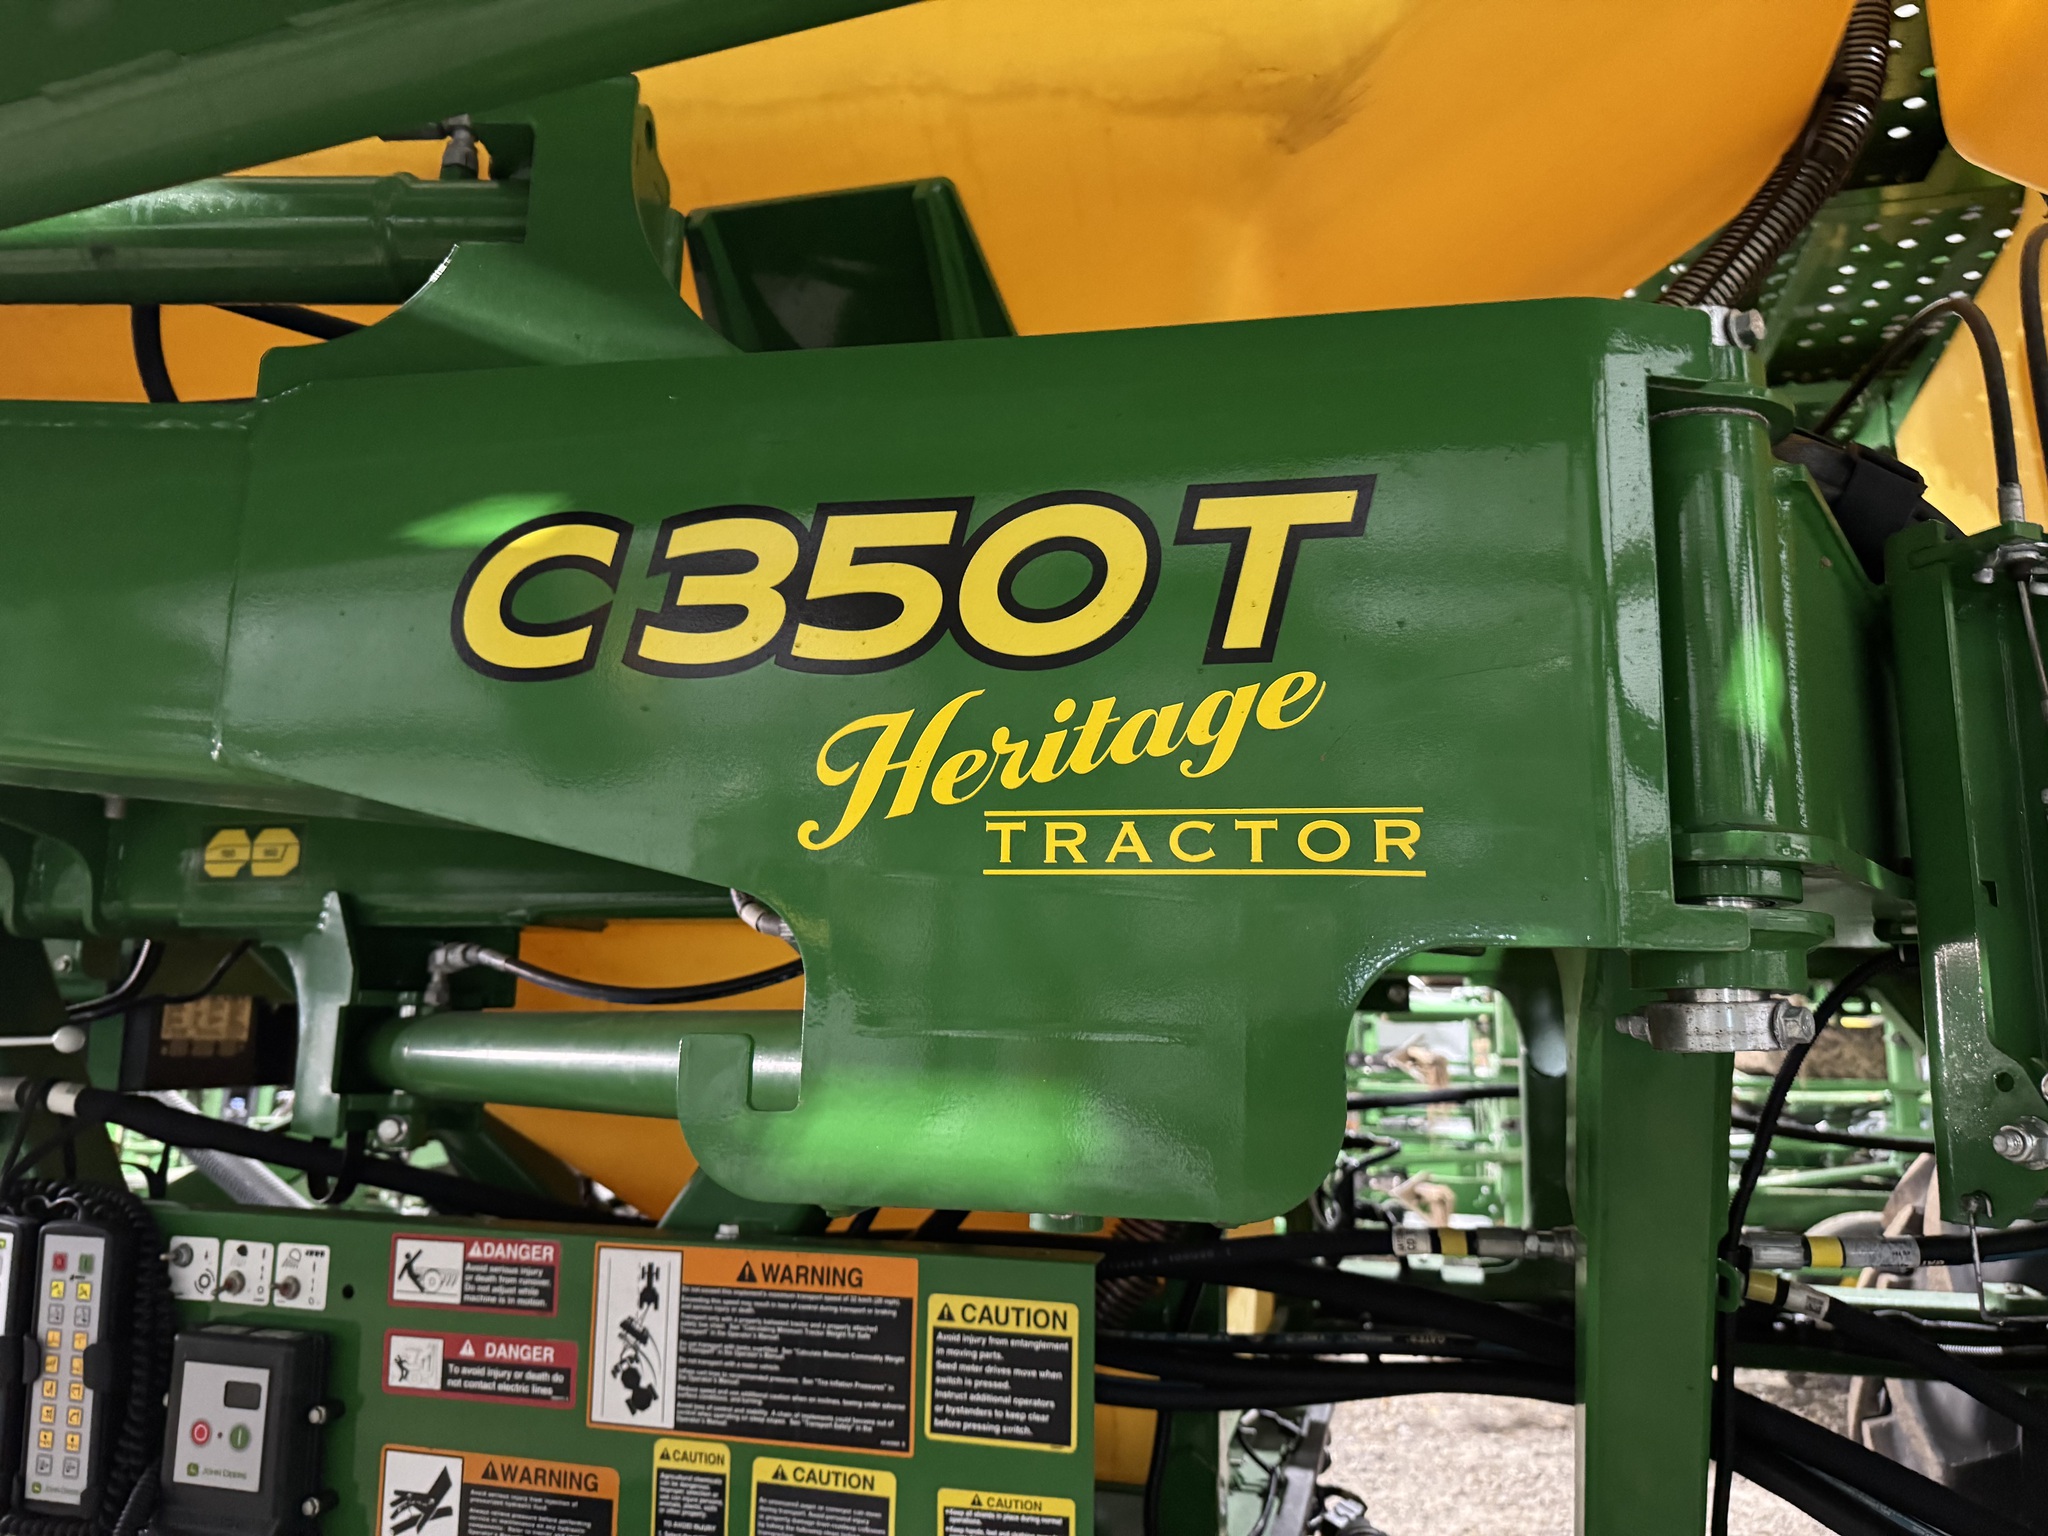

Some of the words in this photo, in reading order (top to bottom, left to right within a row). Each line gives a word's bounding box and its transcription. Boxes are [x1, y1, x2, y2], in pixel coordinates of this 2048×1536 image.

[451, 473, 1377, 682] C350T
[798, 671, 1327, 850] Heritage
[986, 818, 1422, 863] TRACTOR
[483, 1241, 554, 1262] DANGER
[465, 1262, 488, 1273] Avoid
[489, 1266, 519, 1275] serious
[520, 1266, 544, 1278] injury
[475, 1273, 498, 1283] death
[499, 1275, 517, 1284] from
[761, 1262, 864, 1288] WARNING
[463, 1293, 497, 1303] machine
[498, 1295, 506, 1304] is
[507, 1296, 516, 1305] in
[464, 1283, 475, 1292] Do
[477, 1285, 490, 1293] not
[491, 1285, 517, 1296] adjust
[518, 1287, 539, 1296] while
[960, 1302, 1068, 1331] CAUTION
[936, 1331, 961, 1342] Avoid
[962, 1333, 987, 1346] injury
[988, 1335, 1009, 1346] from
[1010, 1338, 1069, 1351] entanglement
[484, 1342, 555, 1363] DANGER
[936, 1346, 944, 1355] in
[946, 1348, 978, 1360] moving
[448, 1363, 460, 1374] To
[460, 1364, 485, 1376] avoid
[487, 1366, 512, 1381] injury
[513, 1370, 524, 1379] or
[525, 1369, 550, 1382] death
[551, 1371, 564, 1384] do
[935, 1360, 957, 1371] Seed
[958, 1362, 983, 1373] meter
[984, 1364, 1012, 1376] drives
[1013, 1368, 1038, 1378] move
[1038, 1369, 1063, 1381] when
[935, 1375, 963, 1386] switch
[964, 1377, 972, 1386] is
[447, 1378, 462, 1388] not
[463, 1379, 496, 1391] contact
[497, 1382, 530, 1394] electric
[934, 1389, 968, 1400] Instruct
[969, 1391, 1012, 1405] additional
[1012, 1396, 1056, 1410] operators
[934, 1404, 944, 1413] or
[945, 1403, 993, 1417] bystanders
[994, 1408, 1004, 1419] to
[1005, 1409, 1027, 1422] keep
[1028, 1411, 1050, 1423] clear
[934, 1417, 961, 1428] before
[962, 1420, 1000, 1435] pressing
[672, 1449, 725, 1466] CAUTION
[500, 1463, 599, 1492] WARNING
[792, 1466, 876, 1492] CAUTION
[986, 1497, 1043, 1512] CAUTION
